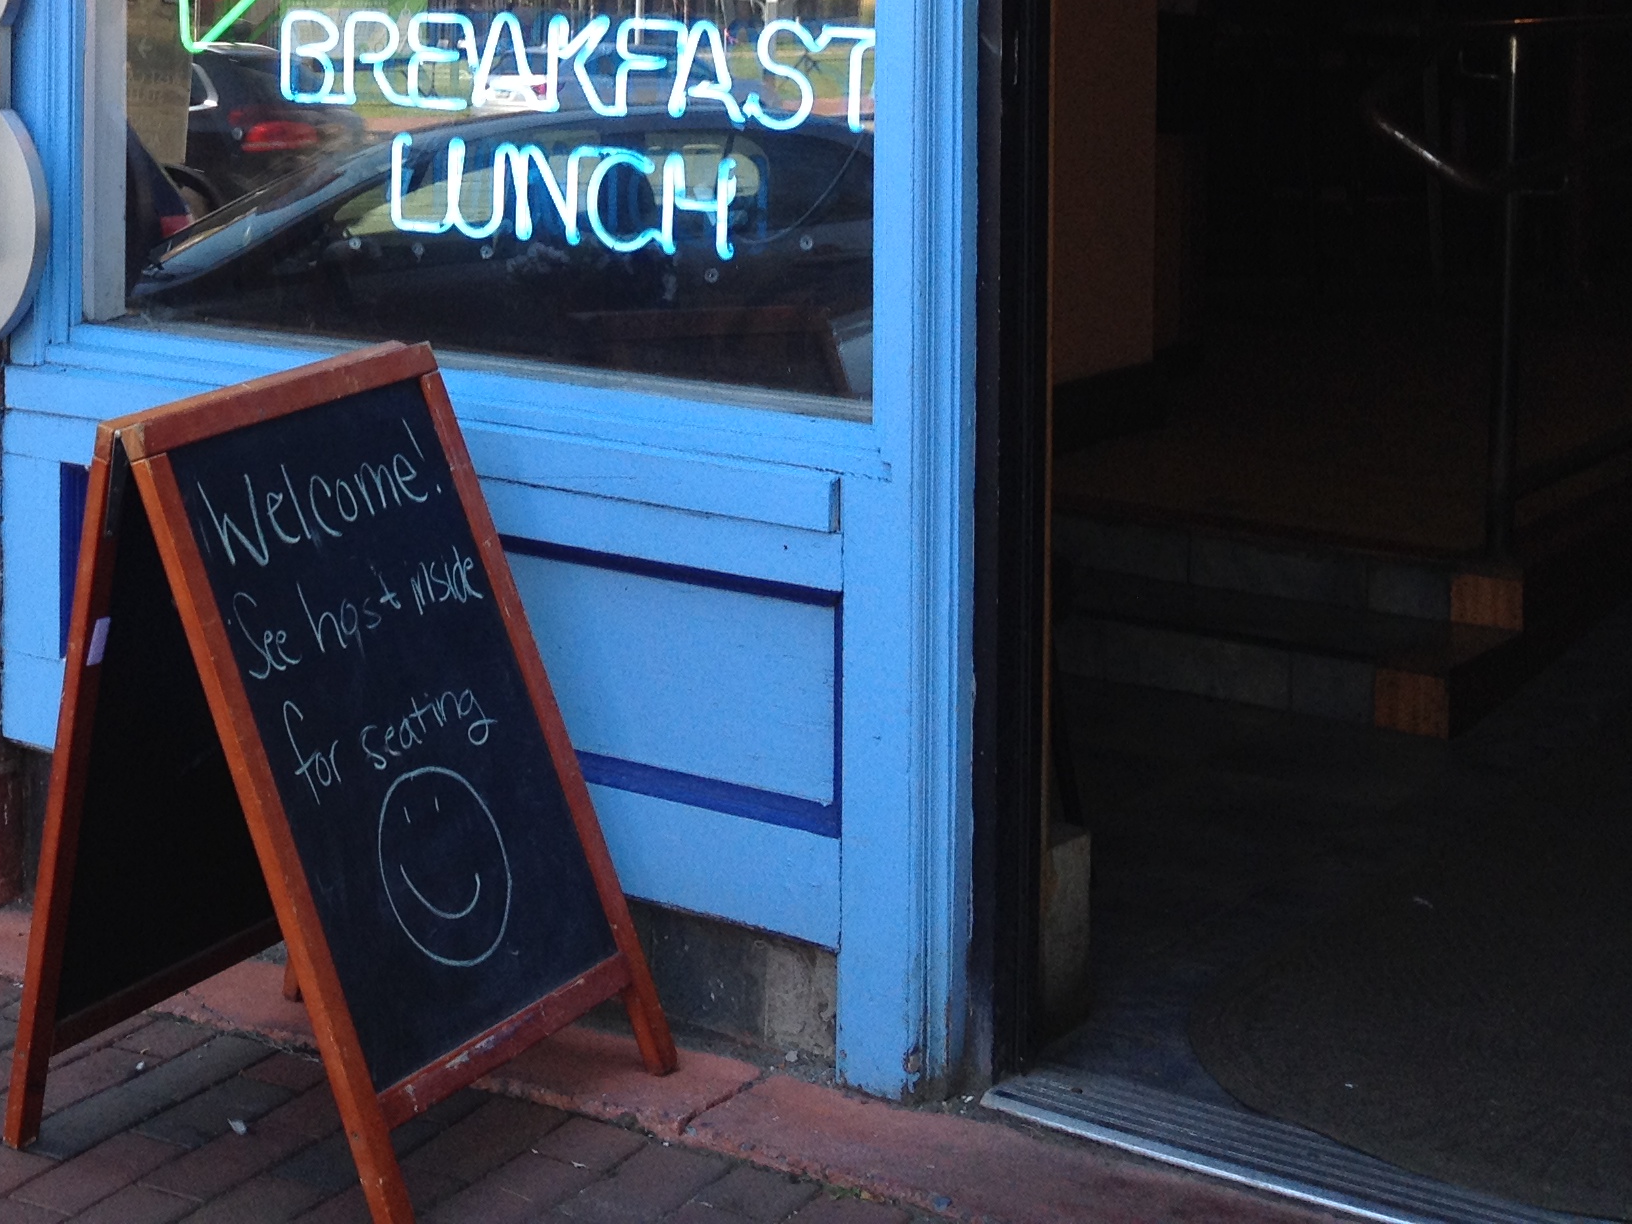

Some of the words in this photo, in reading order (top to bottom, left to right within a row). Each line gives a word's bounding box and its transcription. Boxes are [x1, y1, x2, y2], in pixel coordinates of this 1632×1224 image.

[279, 9, 876, 132] BREAKFAST
[389, 130, 737, 261] LUNCH
[196, 417, 443, 567] Welcome!
[232, 591, 301, 680] See
[295, 566, 402, 656] host
[409, 544, 484, 616] inside
[281, 699, 342, 806] for
[359, 688, 499, 770] seating
